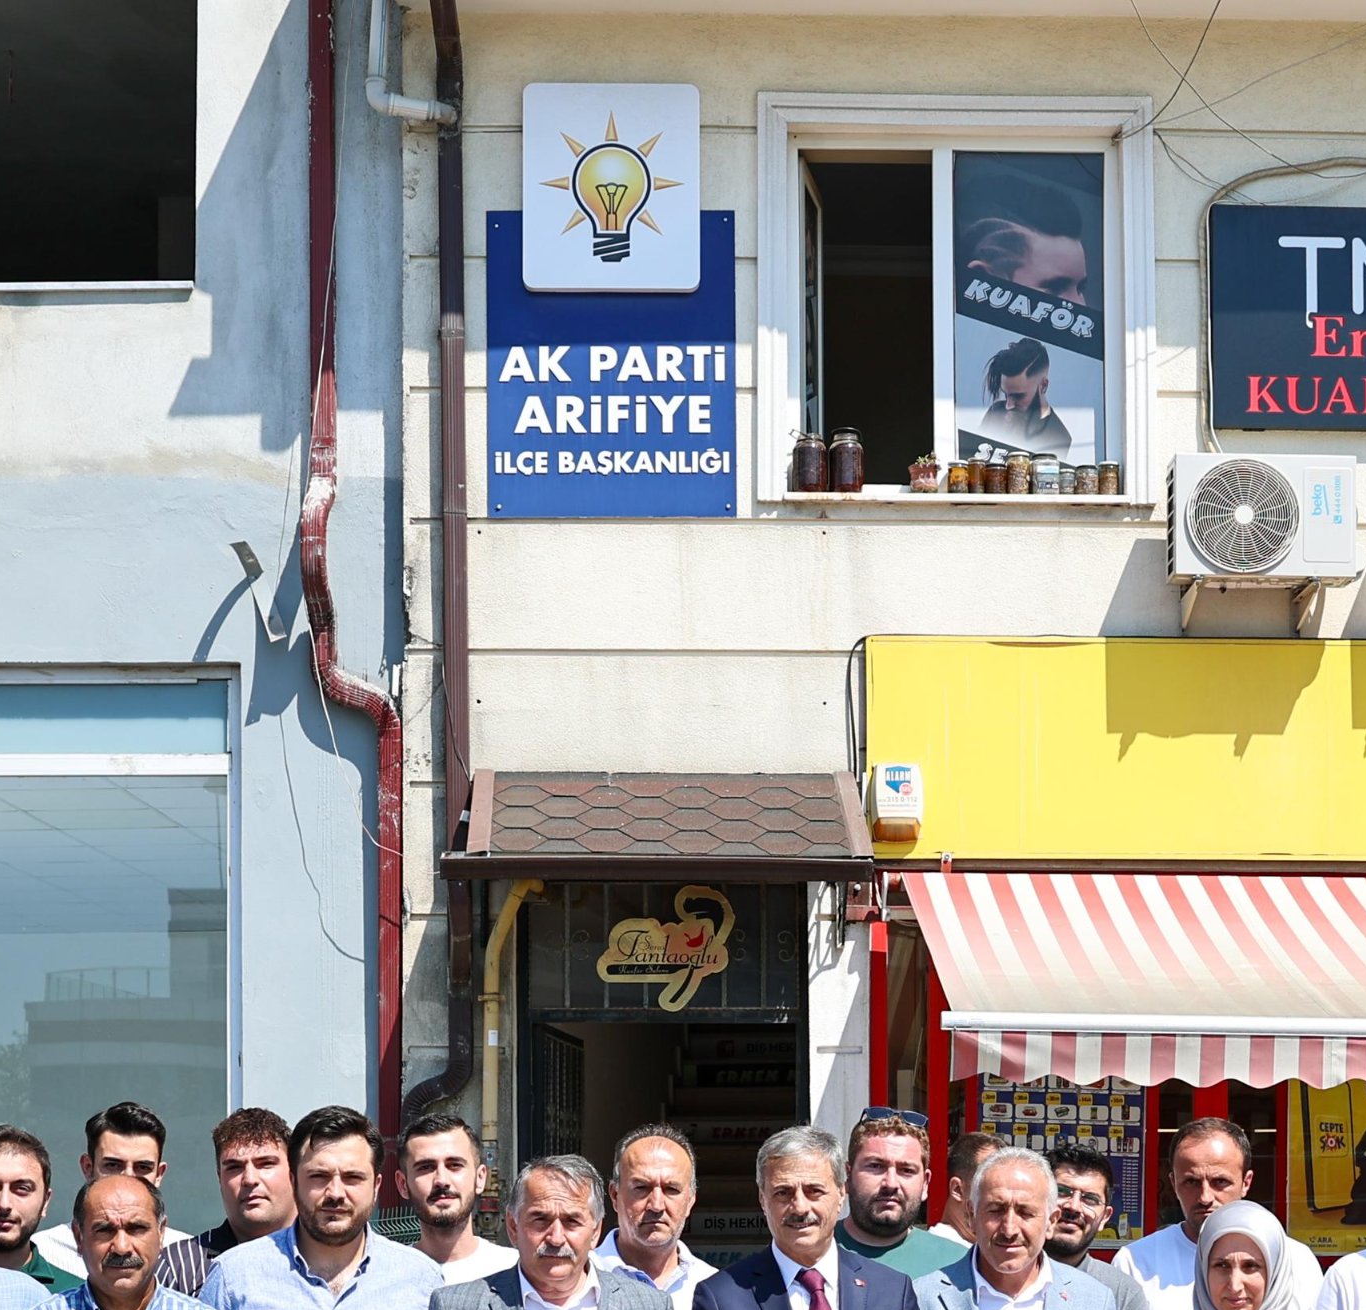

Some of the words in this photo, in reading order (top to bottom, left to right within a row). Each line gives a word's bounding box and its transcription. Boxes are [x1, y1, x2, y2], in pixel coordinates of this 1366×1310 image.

[964, 278, 1095, 338] KUAFÖR
[498, 345, 571, 383] AK
[558, 447, 730, 477] BAŞKANLIĞI
[1311, 484, 1323, 516] beko
[886, 770, 911, 781] ALARM
[1319, 1122, 1344, 1133] CEPTE
[704, 1216, 726, 1231] DİŞ
